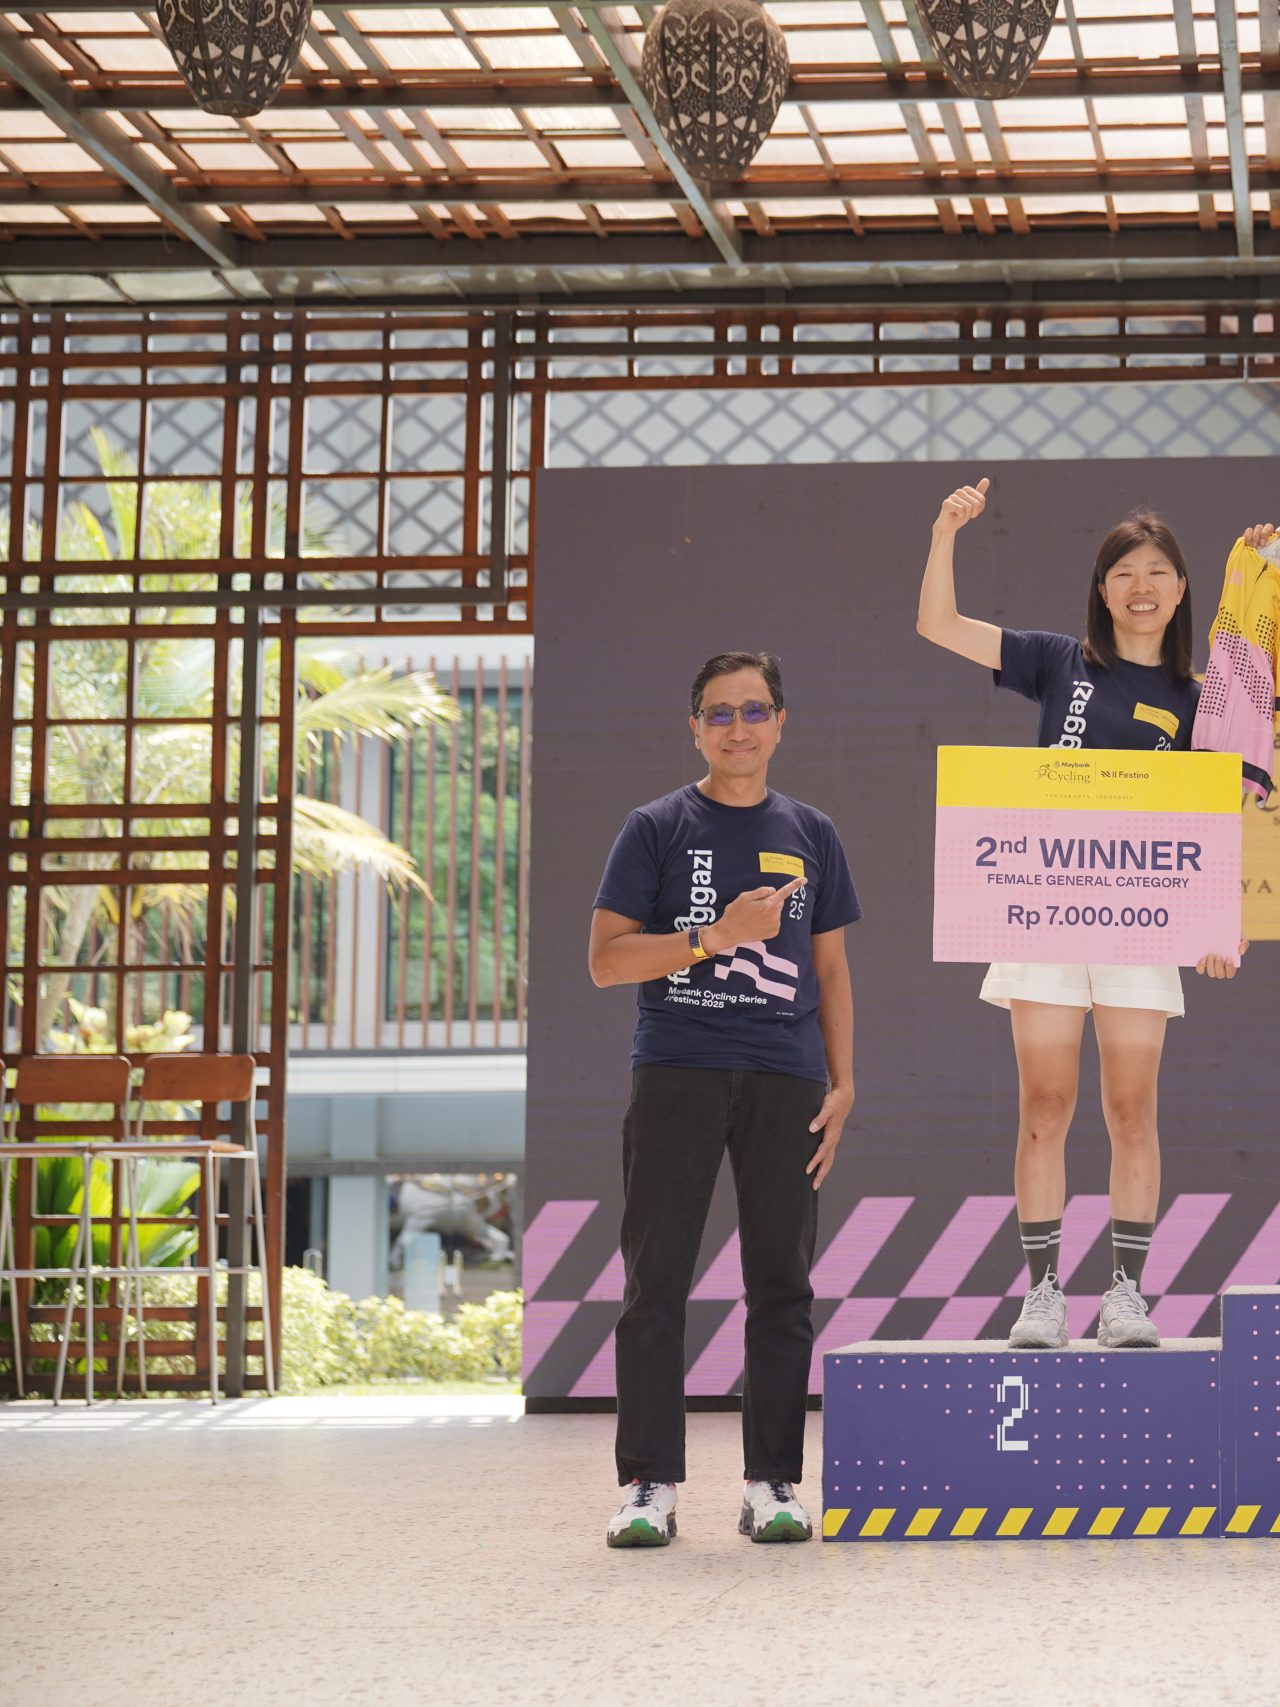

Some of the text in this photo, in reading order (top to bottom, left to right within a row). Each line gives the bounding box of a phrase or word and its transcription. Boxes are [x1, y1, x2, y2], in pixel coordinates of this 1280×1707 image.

[1047, 770, 1090, 784] Cycling
[1119, 771, 1149, 779] Festino
[975, 836, 1202, 871] 2nd WINNER
[987, 873, 1190, 889] FEMALE GENERAL CATEGORY
[789, 901, 804, 920] 25
[1007, 905, 1169, 930] Rp 7.000.000
[701, 1000, 725, 1009] 2025
[703, 990, 737, 1004] Cycling
[739, 994, 767, 1005] Series
[997, 1376, 1028, 1451] 2
